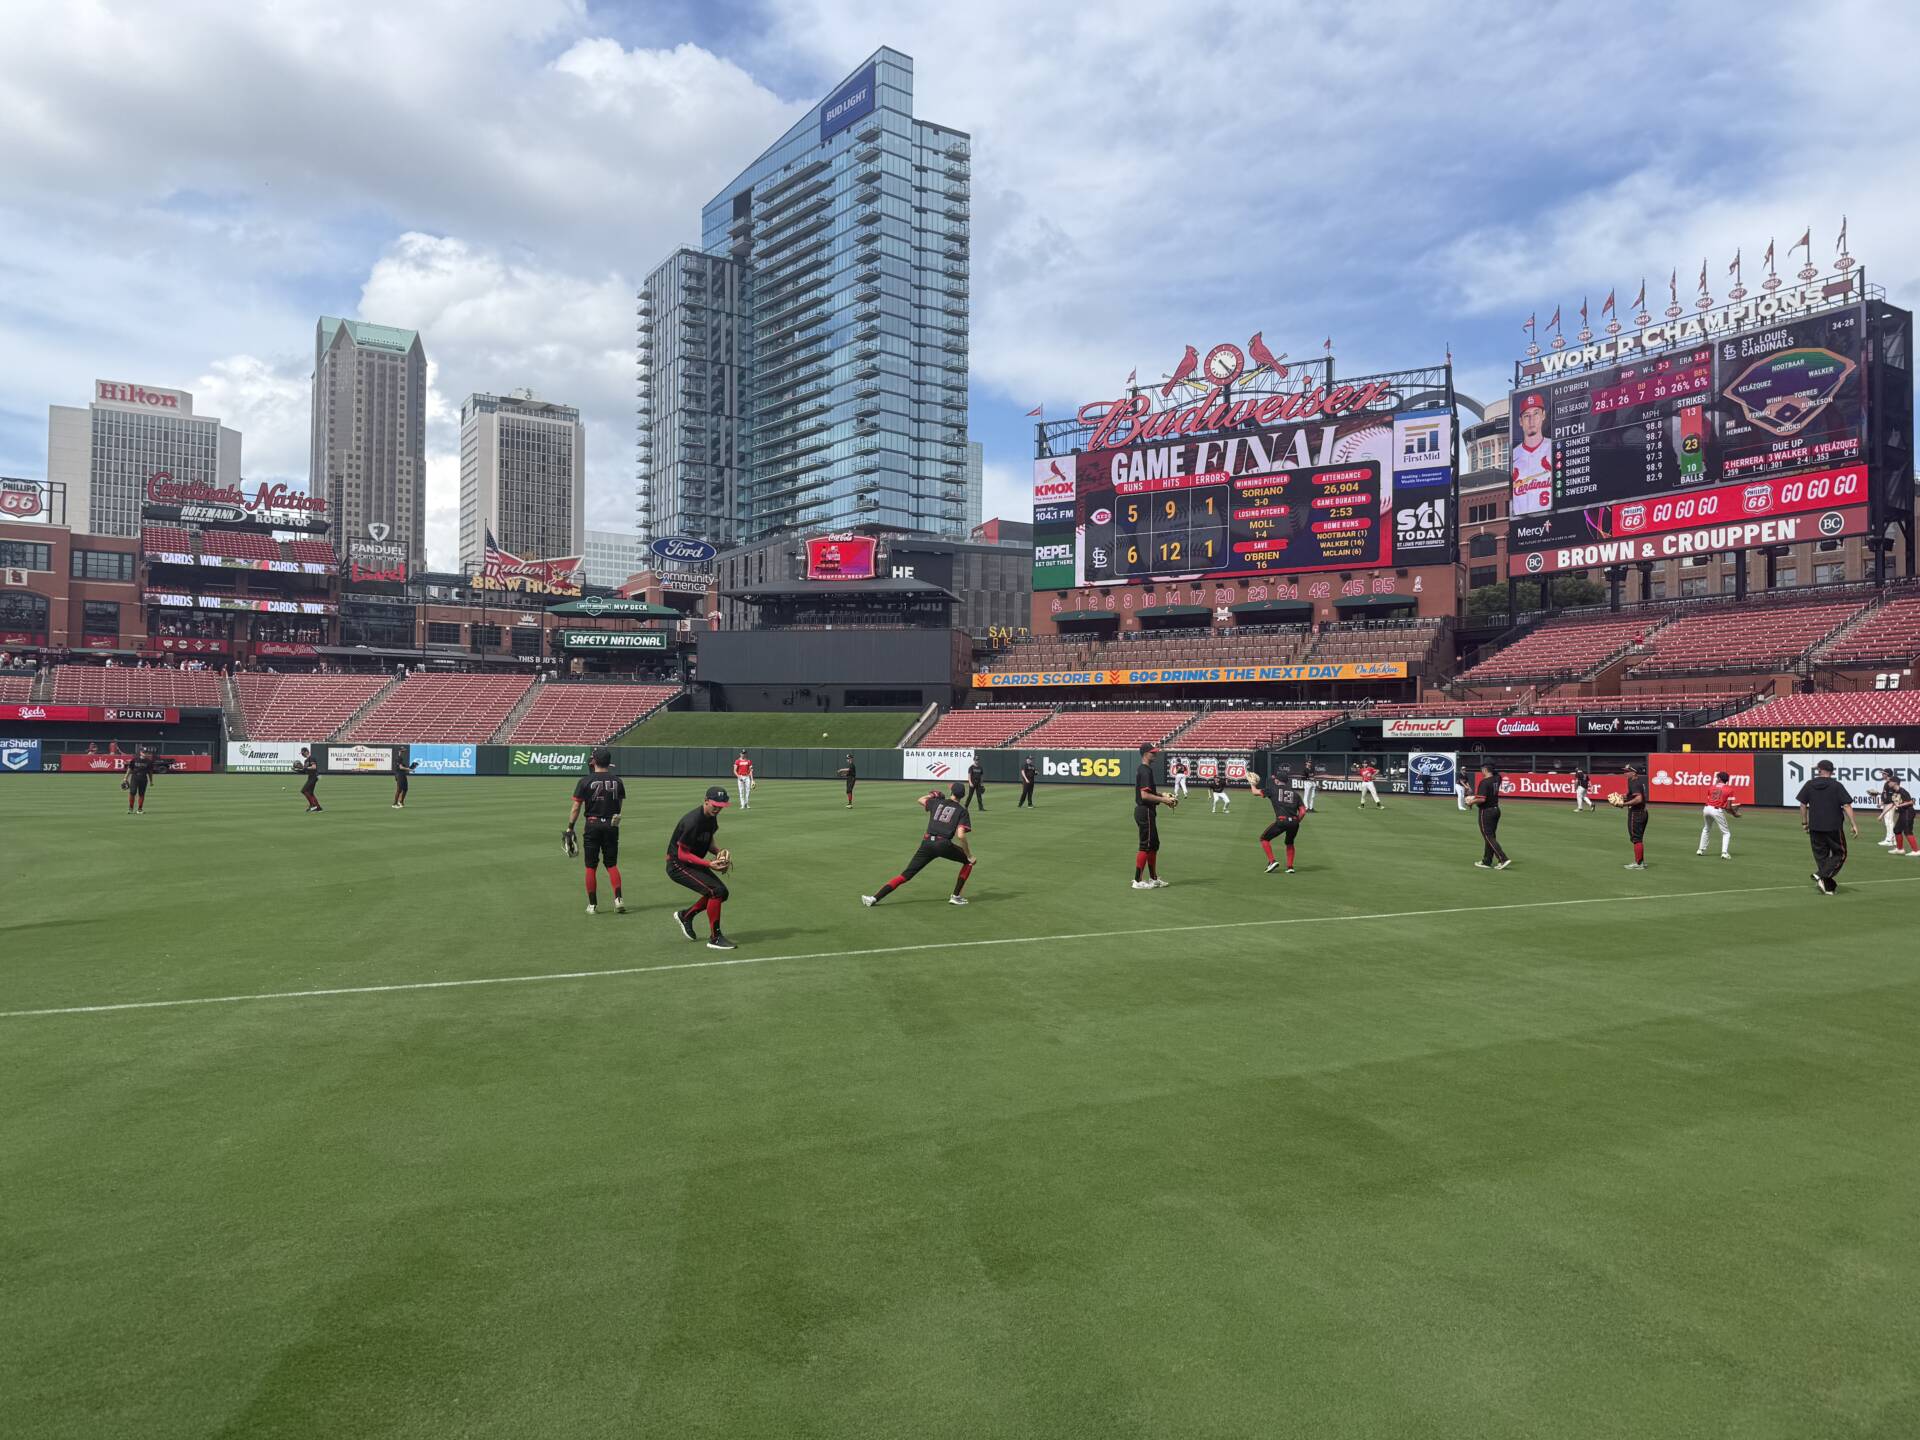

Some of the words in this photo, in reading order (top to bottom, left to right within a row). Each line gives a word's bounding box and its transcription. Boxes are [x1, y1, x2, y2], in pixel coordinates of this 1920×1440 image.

[826, 104, 842, 122] BUD
[843, 88, 867, 111] LIGHT
[1541, 337, 1635, 374] WORLD
[1641, 287, 1825, 348] CHAMPIONS
[1742, 337, 1758, 349] ST.
[1759, 329, 1788, 345] LOUIS
[1741, 337, 1794, 357] CARDINALS
[100, 383, 177, 408] Hilton
[1594, 399, 1614, 410] 28.1
[1618, 396, 1630, 406] 26
[1654, 386, 1667, 397] 30
[1671, 381, 1691, 393] 26%
[1677, 395, 1706, 408] STRIKES
[1077, 378, 1393, 452] Budweiser
[1554, 422, 1585, 439] PITCH
[1565, 436, 1590, 447] SINKER
[1685, 438, 1698, 450] 23
[1772, 441, 1789, 451] DUE
[1790, 438, 1804, 448] UP
[1111, 445, 1186, 486] GAME
[1195, 425, 1340, 478] FINAL
[1403, 455, 1422, 464] First
[1423, 451, 1441, 461] Mid
[1565, 446, 1590, 457] SINKER
[1773, 449, 1808, 463] WALKER
[1565, 456, 1590, 467] SINKER
[1322, 471, 1361, 482] ATTENDANCE
[1565, 466, 1590, 477] SINKER
[1123, 481, 1143, 494] RUNS
[1162, 478, 1180, 489] HITS
[1195, 472, 1226, 485] ERRORS
[1565, 476, 1590, 487] SINKER
[1680, 473, 1704, 484] BALLS
[3, 483, 36, 492] PHILLIPS
[147, 472, 245, 507] Cardinals
[245, 482, 327, 511] Nation
[1035, 482, 1074, 496] KMOX
[1242, 486, 1284, 498] SORIANO
[1324, 482, 1360, 495] 26,904
[1565, 484, 1596, 497] SWEEPER
[1781, 482, 1804, 504] GO
[1807, 479, 1830, 500] GO
[1833, 474, 1857, 496] GO
[5, 495, 34, 510] 66
[1254, 498, 1269, 507] 3-0
[1316, 499, 1334, 507] GAME
[1335, 495, 1367, 505] DURATION
[1749, 497, 1767, 508] 66
[180, 506, 236, 520] HOFFMANN
[1036, 511, 1057, 521] 104.1
[1059, 510, 1074, 518] FM
[1127, 505, 1138, 523] 5
[1165, 501, 1176, 519] 9
[1205, 497, 1213, 515] 1
[1330, 507, 1352, 518] 2:53
[1396, 498, 1445, 531] stl
[1653, 503, 1672, 522] GO
[1675, 499, 1694, 519] GO
[1697, 496, 1718, 515] GO
[255, 514, 311, 526] ROOFTOP
[1249, 520, 1276, 529] MOLL
[1323, 522, 1341, 530] HOME
[1342, 519, 1359, 528] RUNS
[1625, 516, 1640, 527] 66
[1316, 530, 1356, 540] NOOTBAAR
[1396, 528, 1445, 541] TODAY
[1517, 526, 1546, 539] Mercy
[665, 540, 705, 558] Ford
[1319, 540, 1349, 549] WALKER
[1529, 558, 1542, 568] BC
[1557, 540, 1635, 568] BROWN
[1641, 544, 1656, 558] &
[1662, 519, 1796, 555] CROUPPEN
[1823, 517, 1841, 531] BC
[351, 543, 405, 556] FANDUEL
[1035, 544, 1074, 561] REPEL
[1127, 546, 1138, 564] 6
[1160, 542, 1181, 561] 12
[1204, 540, 1213, 558] 1
[161, 552, 194, 566] CARDS
[269, 561, 300, 574] CARDS
[1244, 552, 1280, 561] O'BRIEN
[656, 570, 715, 586] Community
[1089, 595, 1098, 611] 2
[1105, 594, 1115, 610] 6
[1123, 592, 1133, 609] 9
[1142, 592, 1156, 609] 10
[1165, 590, 1180, 606] 14
[1190, 589, 1205, 606] 17
[1215, 587, 1235, 605] 20
[1247, 585, 1268, 602] 23
[1277, 583, 1298, 600] 24
[1308, 581, 1331, 599] 42
[1341, 579, 1365, 597] 45
[1372, 577, 1396, 594] 85
[160, 594, 193, 608] CARDS
[267, 601, 298, 613] CARDS
[614, 603, 629, 611] MVP
[570, 635, 608, 645] SAFETY
[610, 636, 662, 646] NATIONAL
[991, 674, 1039, 686] CARDS
[1042, 673, 1090, 685] SCORE
[1093, 672, 1104, 684] 6
[1160, 668, 1220, 683] DRINKS
[1224, 668, 1260, 681] THE
[1264, 667, 1304, 680] NEXT
[1307, 665, 1342, 679] DAY
[18, 706, 47, 720] Reds
[120, 710, 164, 720] PURINA
[1497, 718, 1541, 735] Cardinals
[1588, 720, 1612, 733] Mercy
[0, 739, 38, 749] arShield
[248, 749, 280, 759] Ameren
[905, 750, 926, 758] BANK
[927, 750, 936, 758] OF
[1042, 756, 1121, 777] bet365
[1417, 756, 1446, 771] Ford
[1200, 766, 1216, 775] 66
[1230, 766, 1247, 775] 66
[1811, 767, 1920, 782] PRFICEN
[1322, 780, 1364, 791] STADIUM
[1713, 771, 1750, 787] Frm
[590, 779, 619, 801] 24
[1520, 777, 1601, 796] Budweir
[1278, 788, 1294, 803] 13
[933, 804, 956, 823] 19
